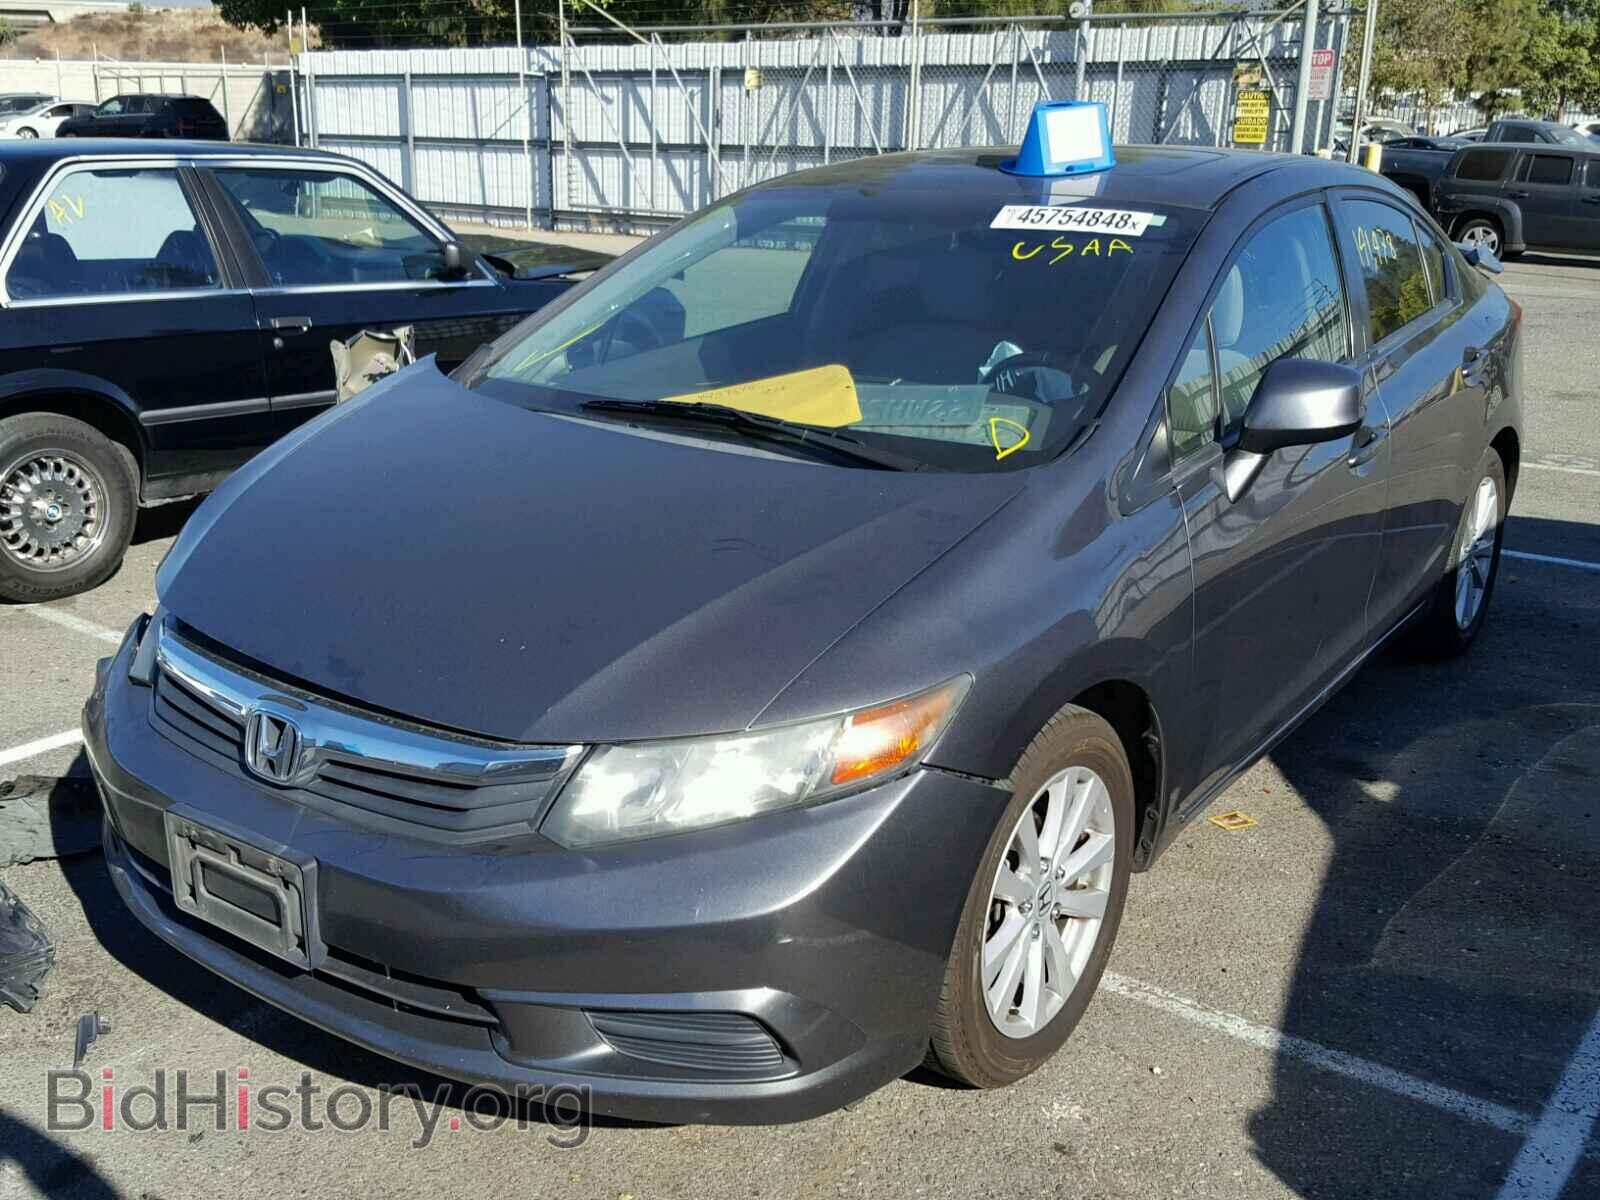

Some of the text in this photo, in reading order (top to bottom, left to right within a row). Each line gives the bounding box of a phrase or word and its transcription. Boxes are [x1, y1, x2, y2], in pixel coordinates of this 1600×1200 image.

[1312, 53, 1332, 65] TOP
[1012, 236, 1134, 265] USAA
[989, 416, 1030, 461] D
